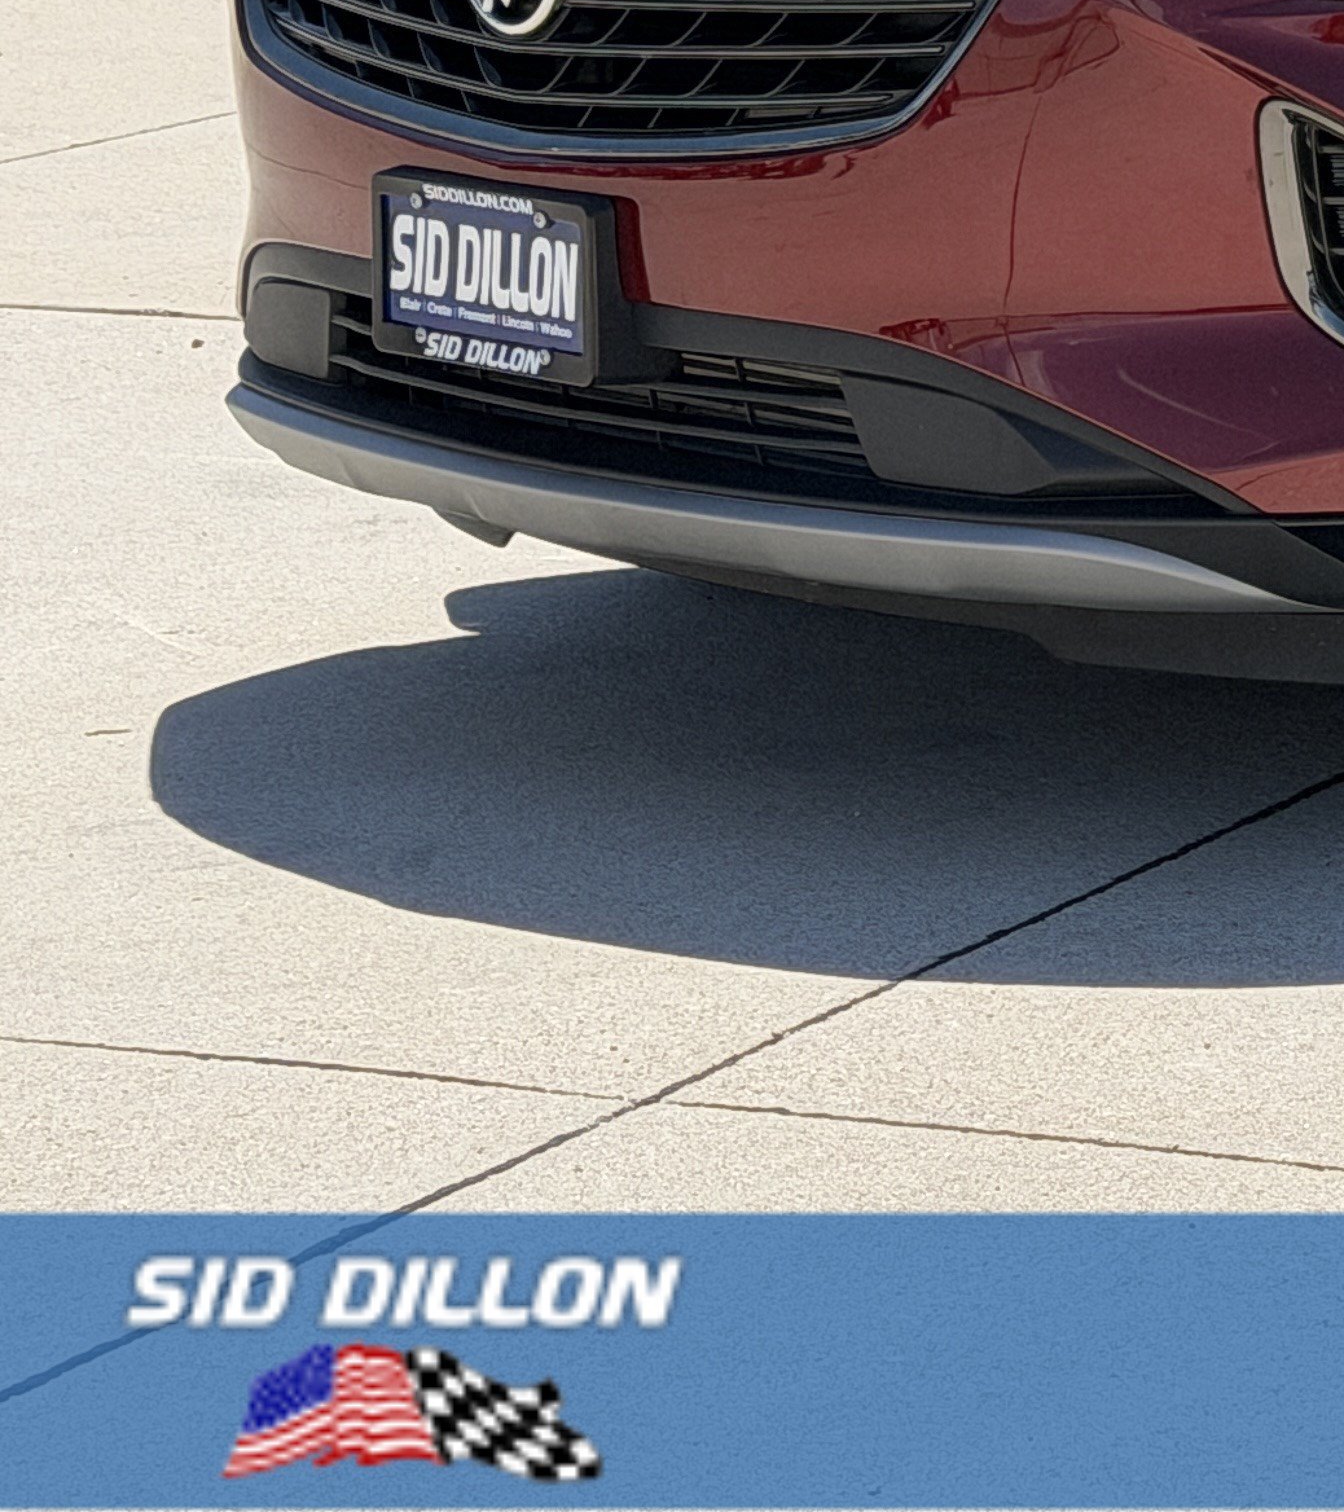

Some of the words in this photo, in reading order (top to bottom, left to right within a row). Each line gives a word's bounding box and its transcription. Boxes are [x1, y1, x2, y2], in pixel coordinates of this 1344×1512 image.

[421, 183, 533, 216] SIDDILLON.COM
[389, 214, 450, 298] SID
[455, 224, 579, 322] DILLON
[423, 332, 463, 360] SID
[464, 339, 542, 375] DILLON
